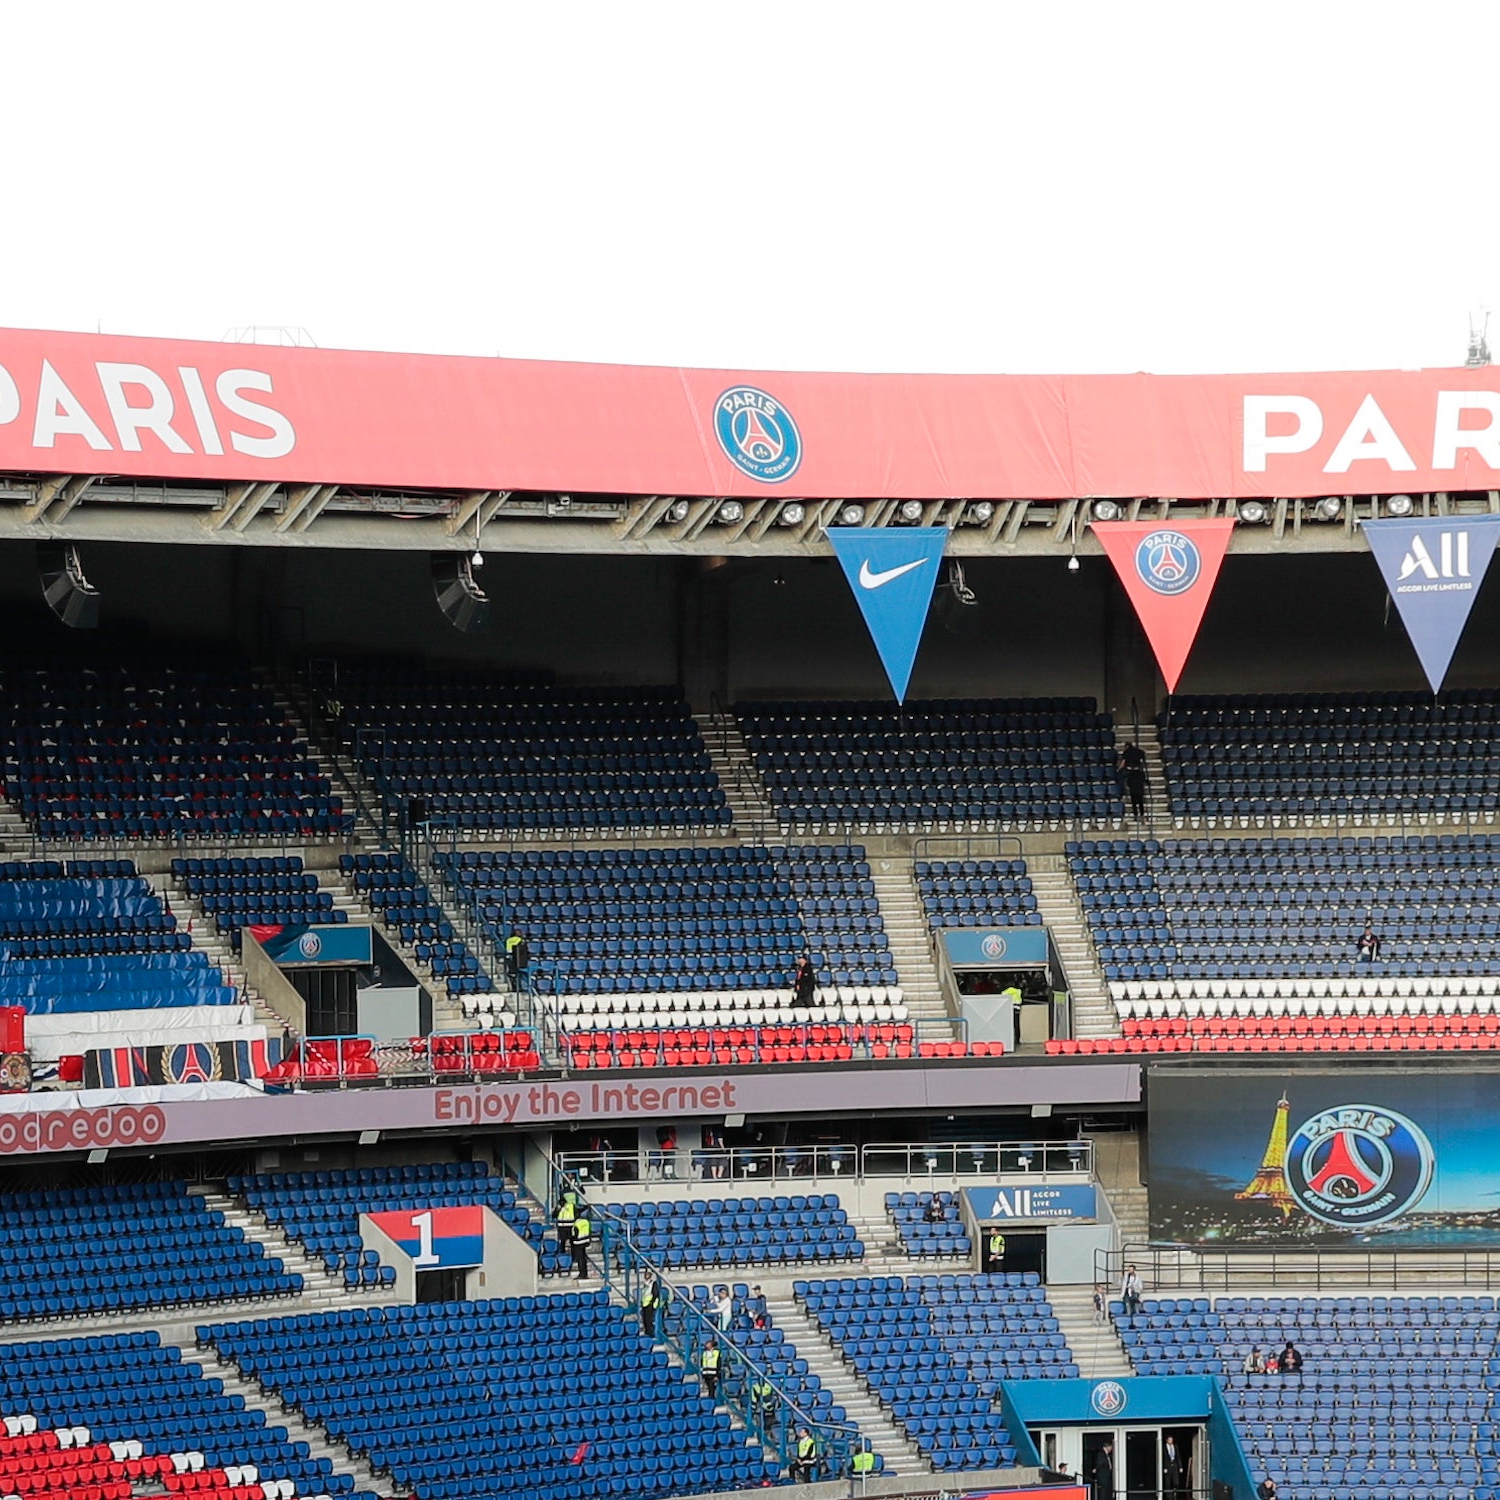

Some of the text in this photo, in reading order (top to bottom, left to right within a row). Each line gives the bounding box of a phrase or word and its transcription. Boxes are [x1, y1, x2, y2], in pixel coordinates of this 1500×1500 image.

[722, 392, 777, 415] PARIS
[1145, 534, 1187, 549] PARIS
[435, 1081, 735, 1124] Enjoy the Internet
[1301, 1110, 1395, 1140] PARIS
[410, 1212, 439, 1265] 1
